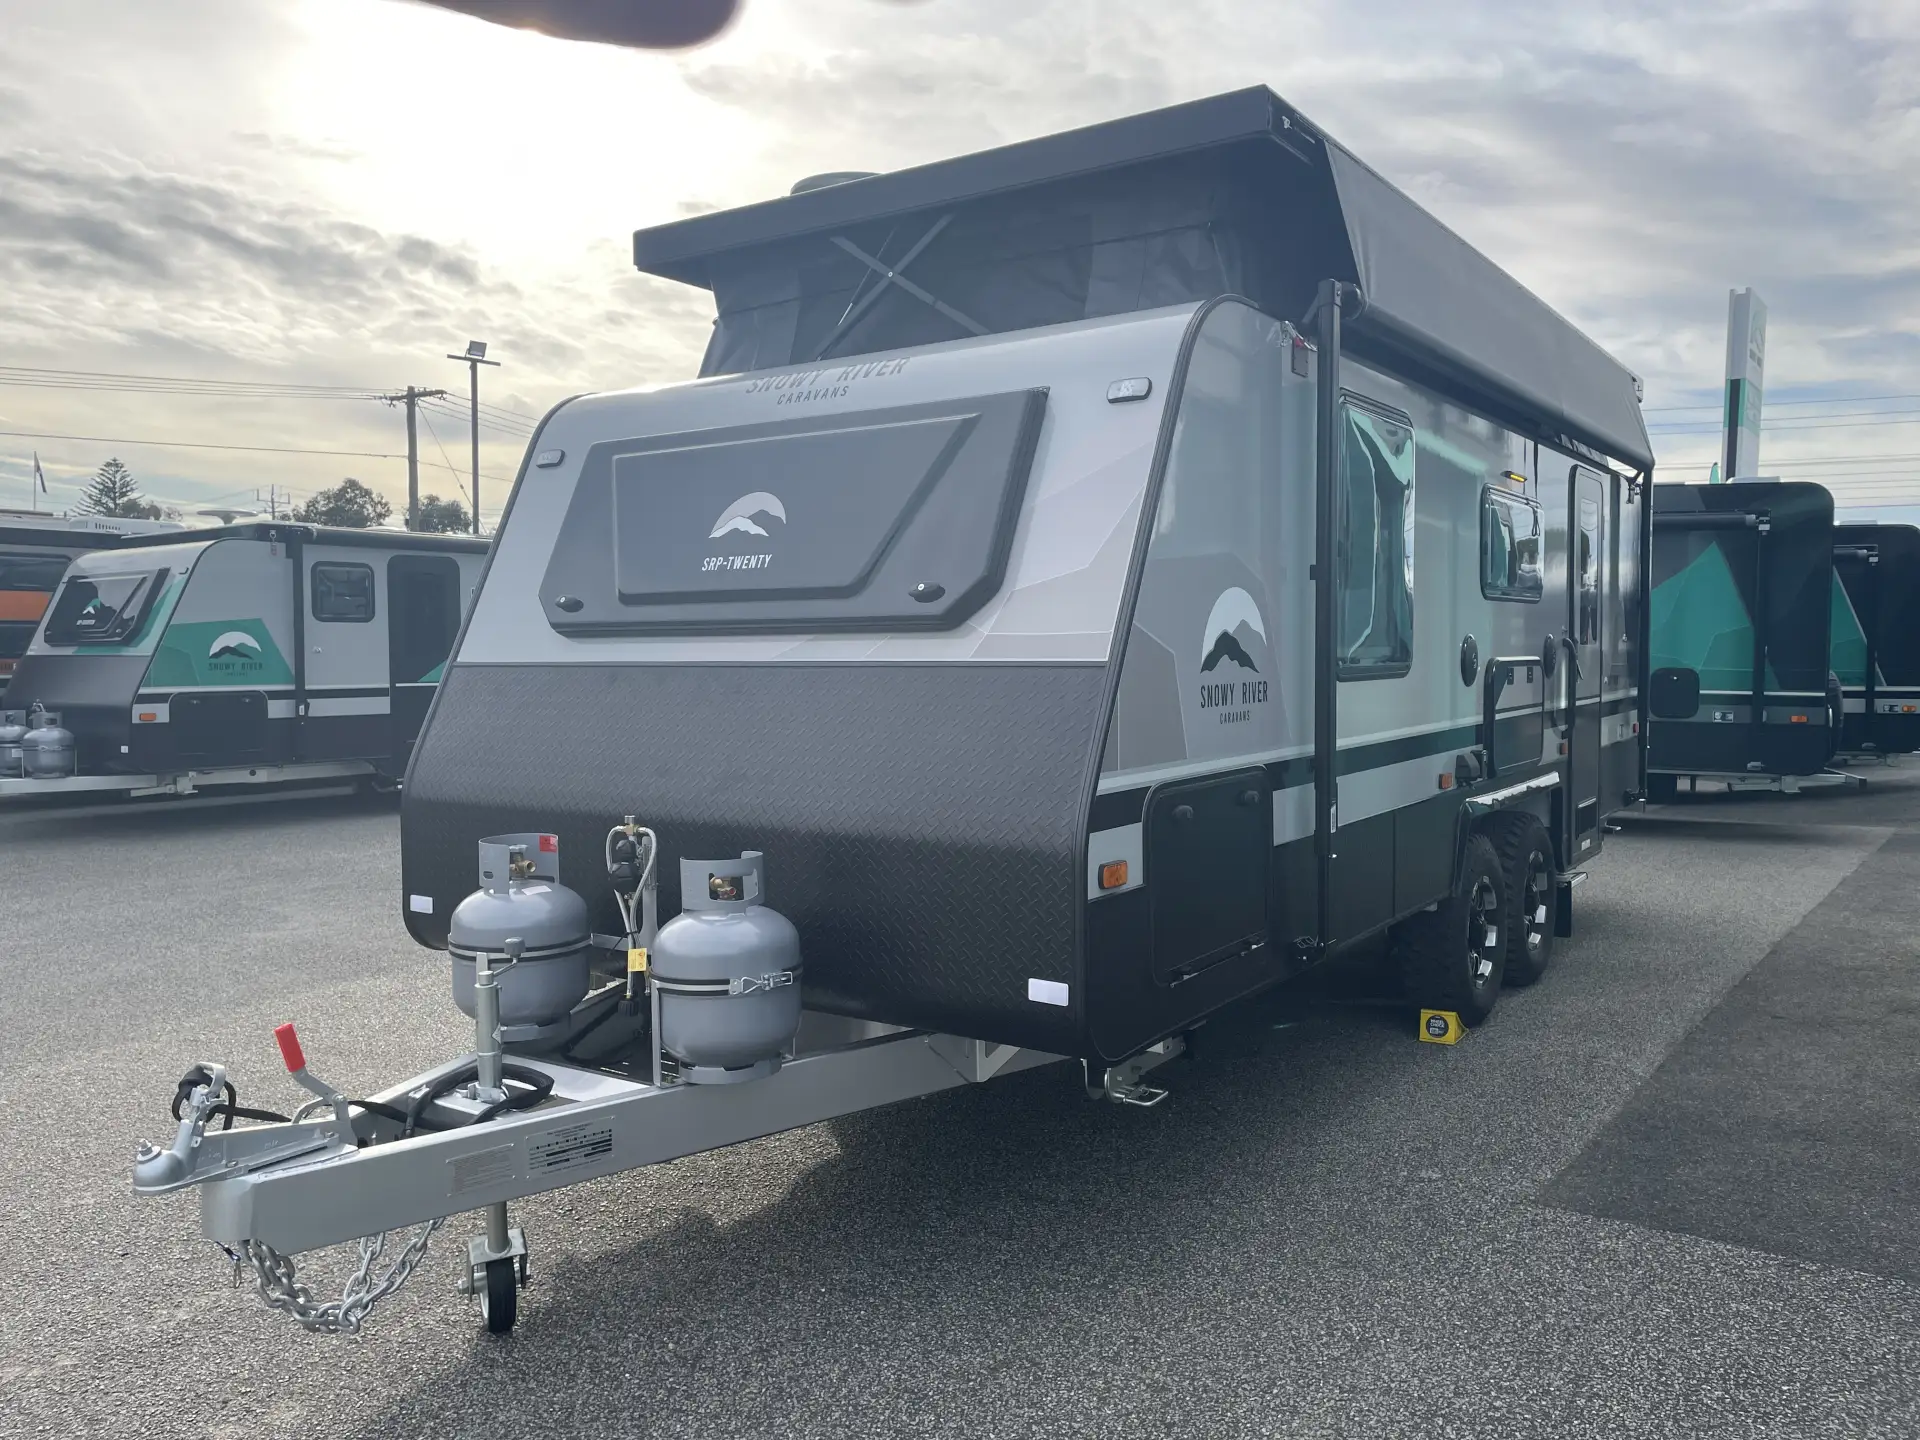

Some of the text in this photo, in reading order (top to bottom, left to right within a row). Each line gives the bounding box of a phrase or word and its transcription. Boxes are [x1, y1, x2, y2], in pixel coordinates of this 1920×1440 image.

[746, 357, 910, 393] SNOWY RIVER
[776, 385, 850, 405] CARAVANS
[701, 553, 773, 572] SRP-TWENTY
[1200, 681, 1268, 708] SNOWY RIVER
[1220, 710, 1250, 724] CARAVANS
